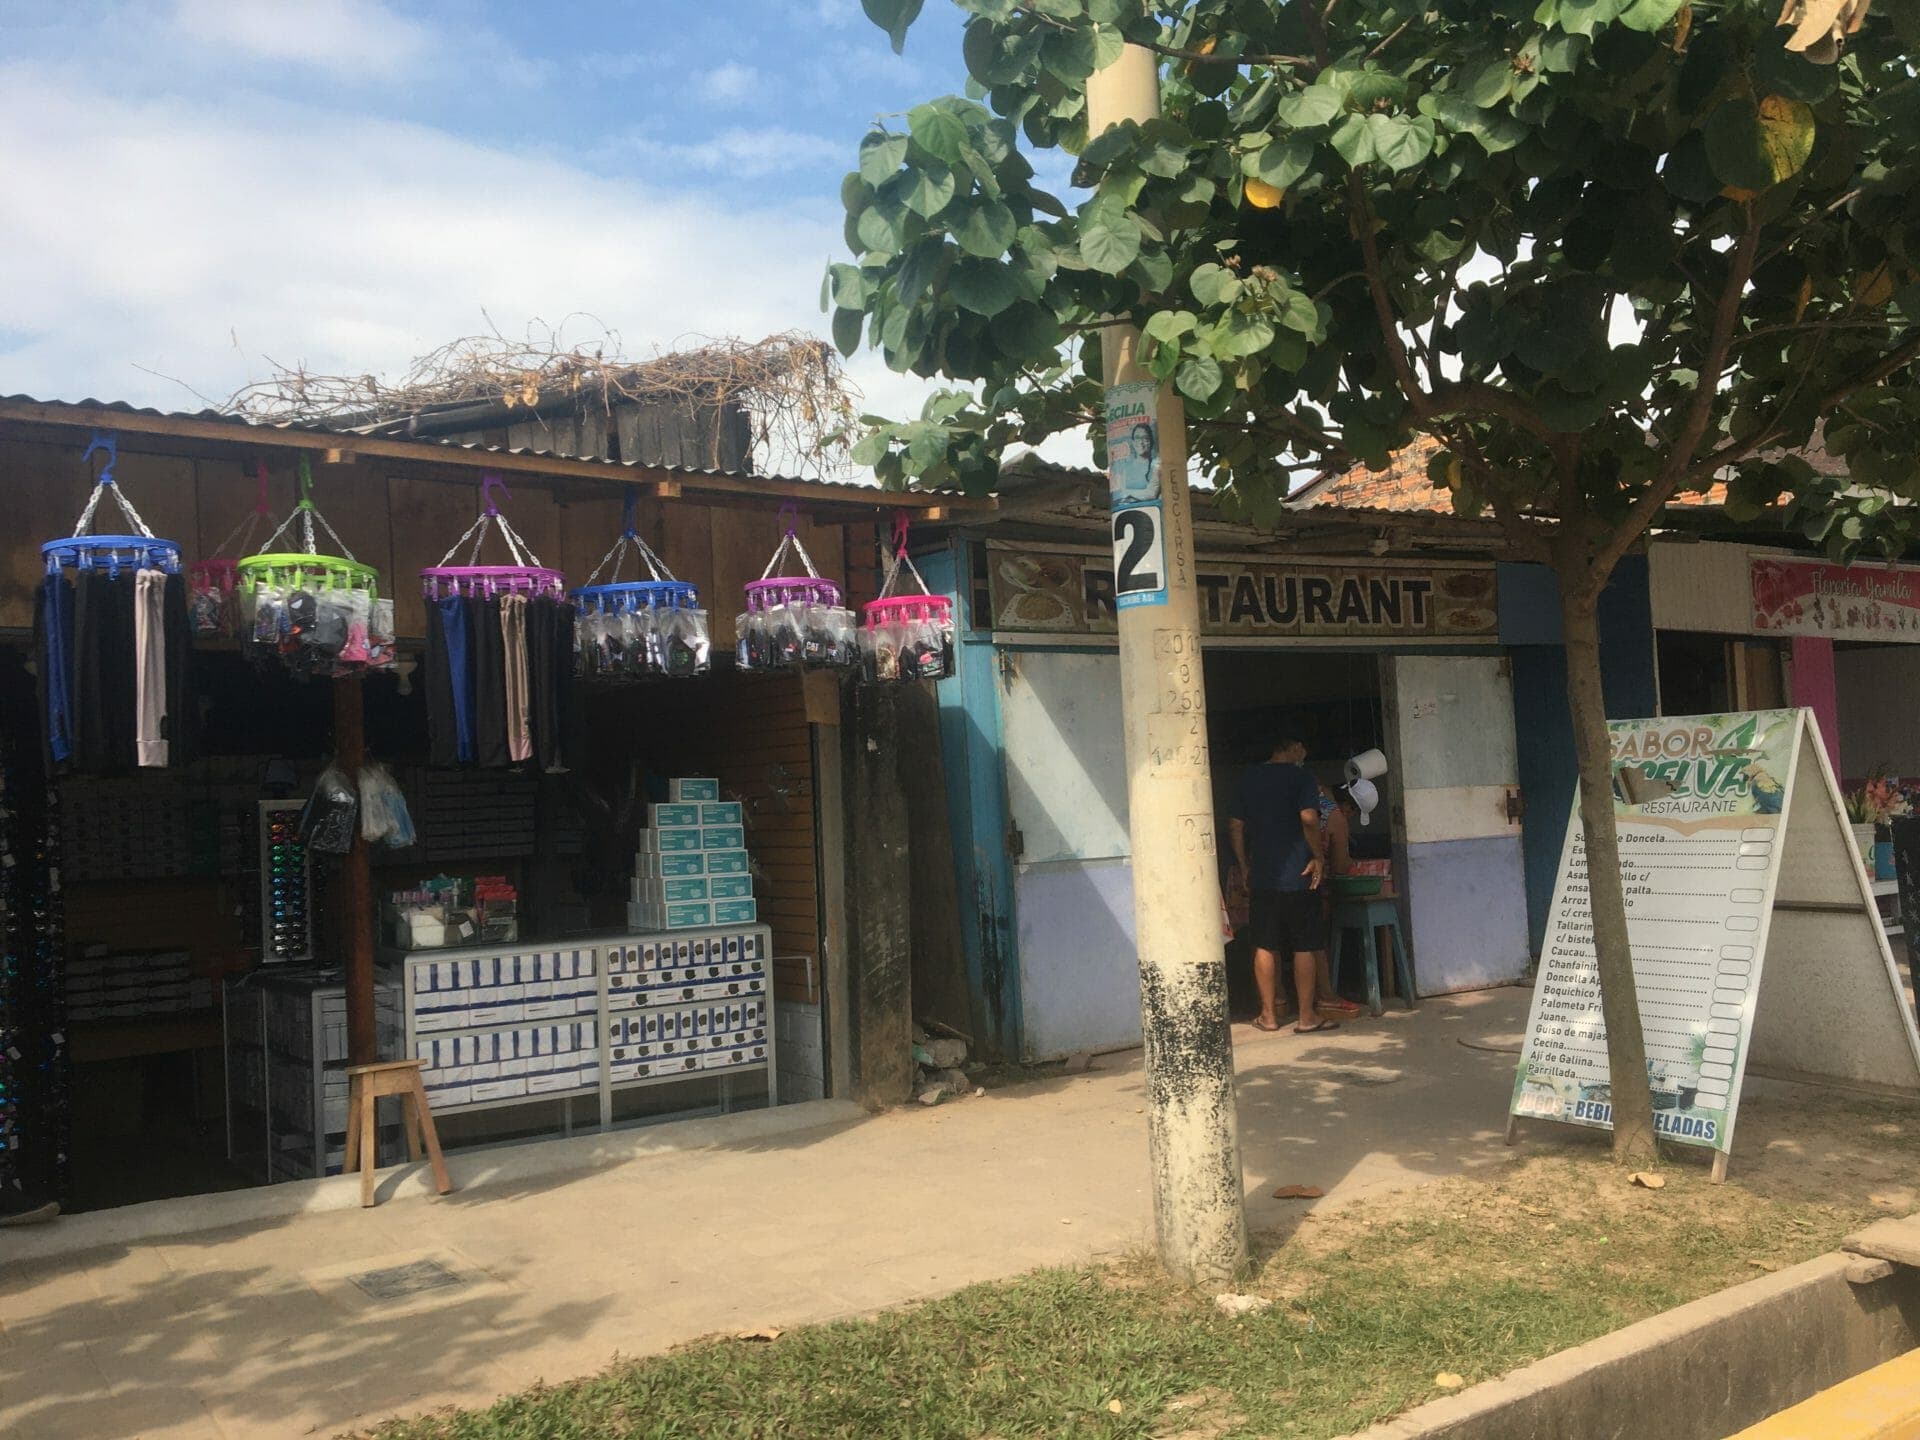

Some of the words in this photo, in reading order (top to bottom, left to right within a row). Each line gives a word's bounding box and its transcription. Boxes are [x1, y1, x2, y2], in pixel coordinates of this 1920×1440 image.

[1104, 403, 1145, 422] ECILIA
[1170, 468, 1187, 584] ESCARSA
[1114, 510, 1158, 594] 2
[1084, 567, 1432, 625] RTAURANT
[1642, 800, 1736, 814] RESTAURANTE
[1626, 833, 1666, 844] Doncela
[1570, 858, 1588, 867] Lom
[1626, 886, 1652, 896] palta
[1561, 895, 1588, 905] Arroz
[1551, 946, 1585, 957] Caucau
[1546, 971, 1587, 984] Doncella
[1543, 984, 1595, 999] Boquichico
[1541, 998, 1585, 1011] Palometa
[1538, 1011, 1566, 1023] Juane
[1536, 1024, 1562, 1036] Guiso
[1564, 1027, 1576, 1036] de
[1533, 1037, 1565, 1050] Cecina
[1545, 1052, 1557, 1062] de
[1528, 1063, 1576, 1079] Parrillada
[1575, 1100, 1614, 1122] BEBI
